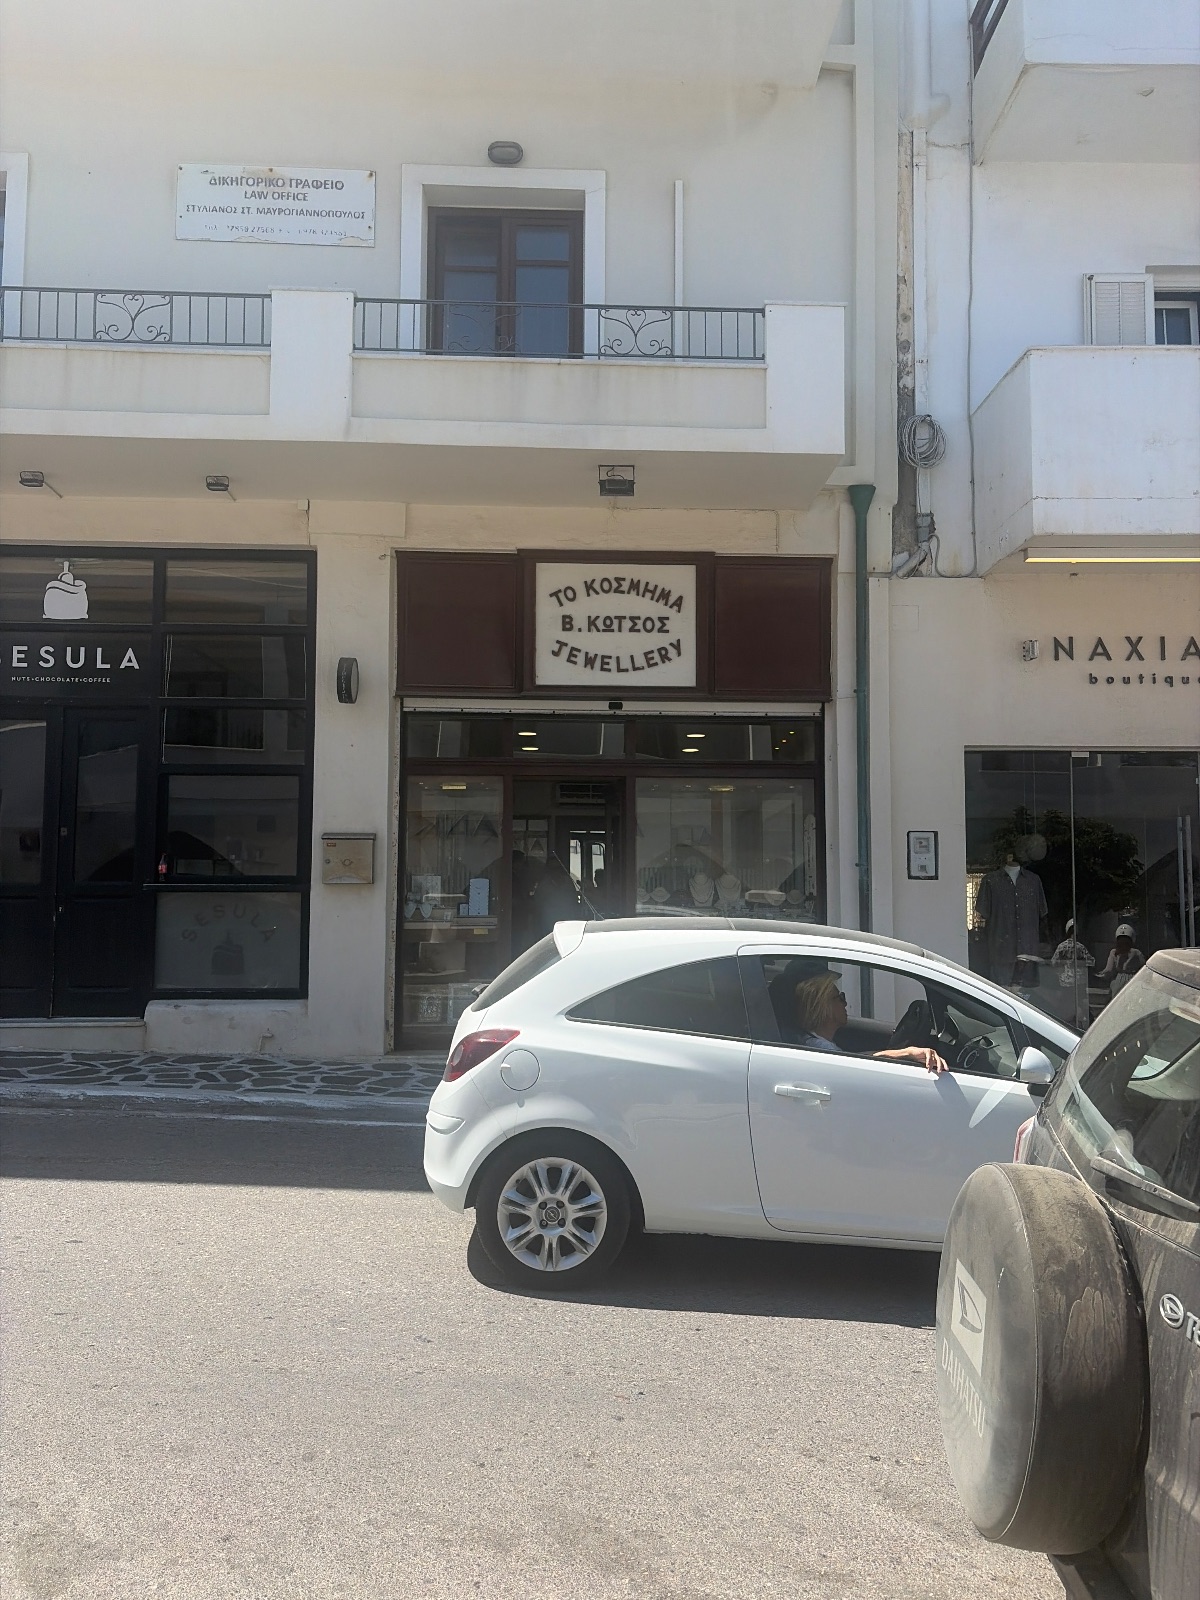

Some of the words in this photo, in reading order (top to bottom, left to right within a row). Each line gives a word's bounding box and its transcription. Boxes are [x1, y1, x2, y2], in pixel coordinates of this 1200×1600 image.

[208, 175, 286, 188] ΔΙΚΗΓΟΡΙΚΟ
[289, 178, 345, 190] ΓΡΑΦΕΙΟ
[244, 190, 268, 200] LAW
[271, 191, 309, 201] OFFICE
[186, 204, 238, 214] ΣΤΥΛΙΑΝΟΣ
[549, 586, 577, 607] ΤΟ
[583, 577, 684, 613] ΚΟΣΜΗΜΑ
[0, 645, 140, 669] ESULA
[551, 638, 682, 673] JEWELLERY
[1053, 636, 1200, 661] NAXIA
[1089, 673, 1200, 687] boutiqu
[181, 904, 276, 943] SESULA
[942, 1337, 986, 1438] DAIHATSU
